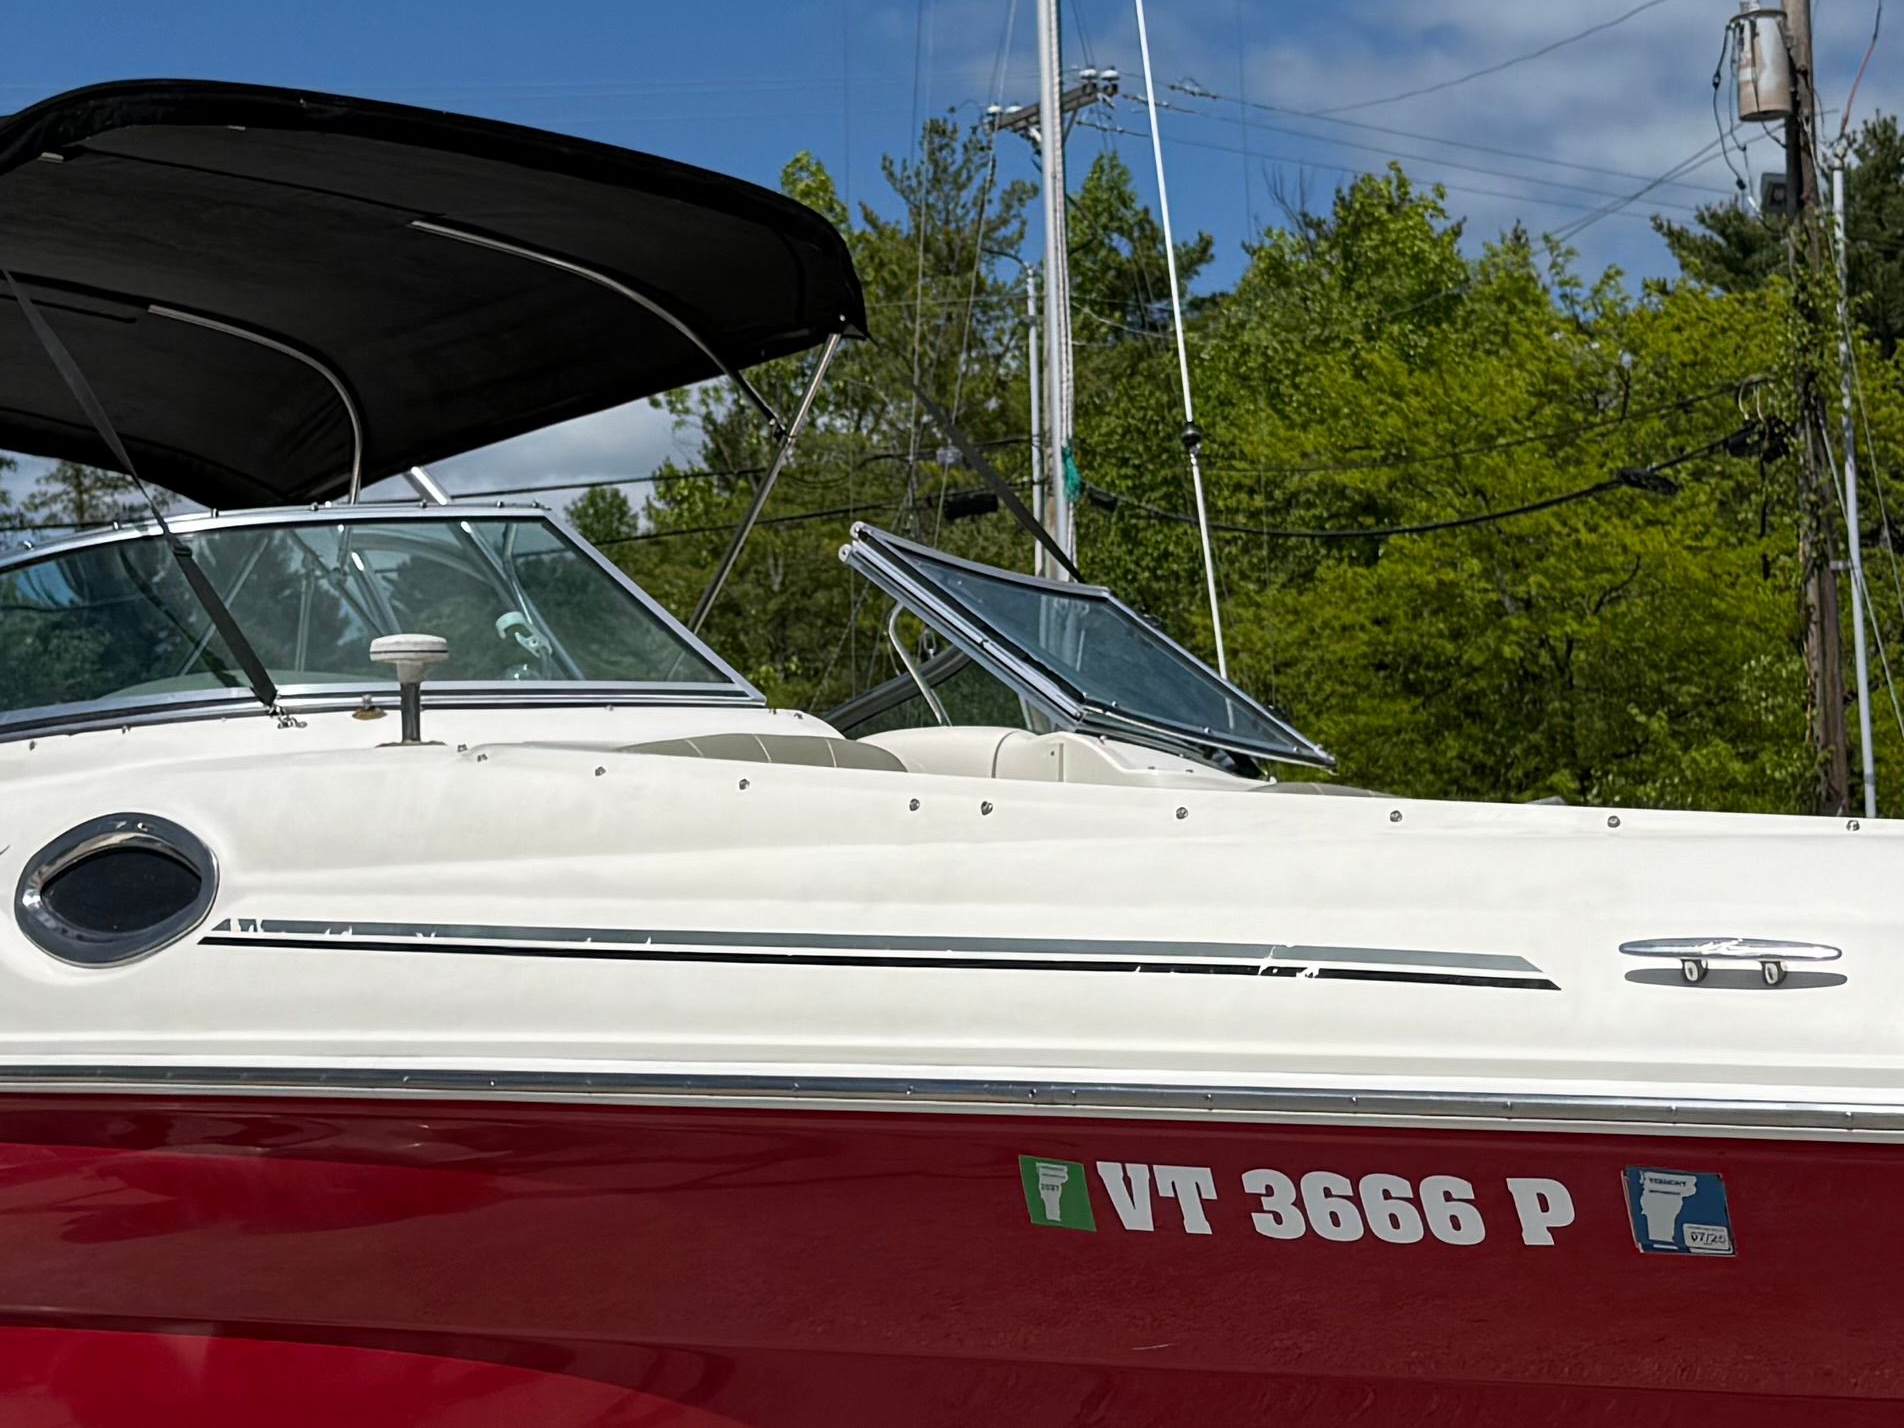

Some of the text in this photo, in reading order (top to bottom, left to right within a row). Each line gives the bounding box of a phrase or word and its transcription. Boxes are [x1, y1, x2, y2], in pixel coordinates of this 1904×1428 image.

[1095, 1160, 1576, 1246] VT 3666 P
